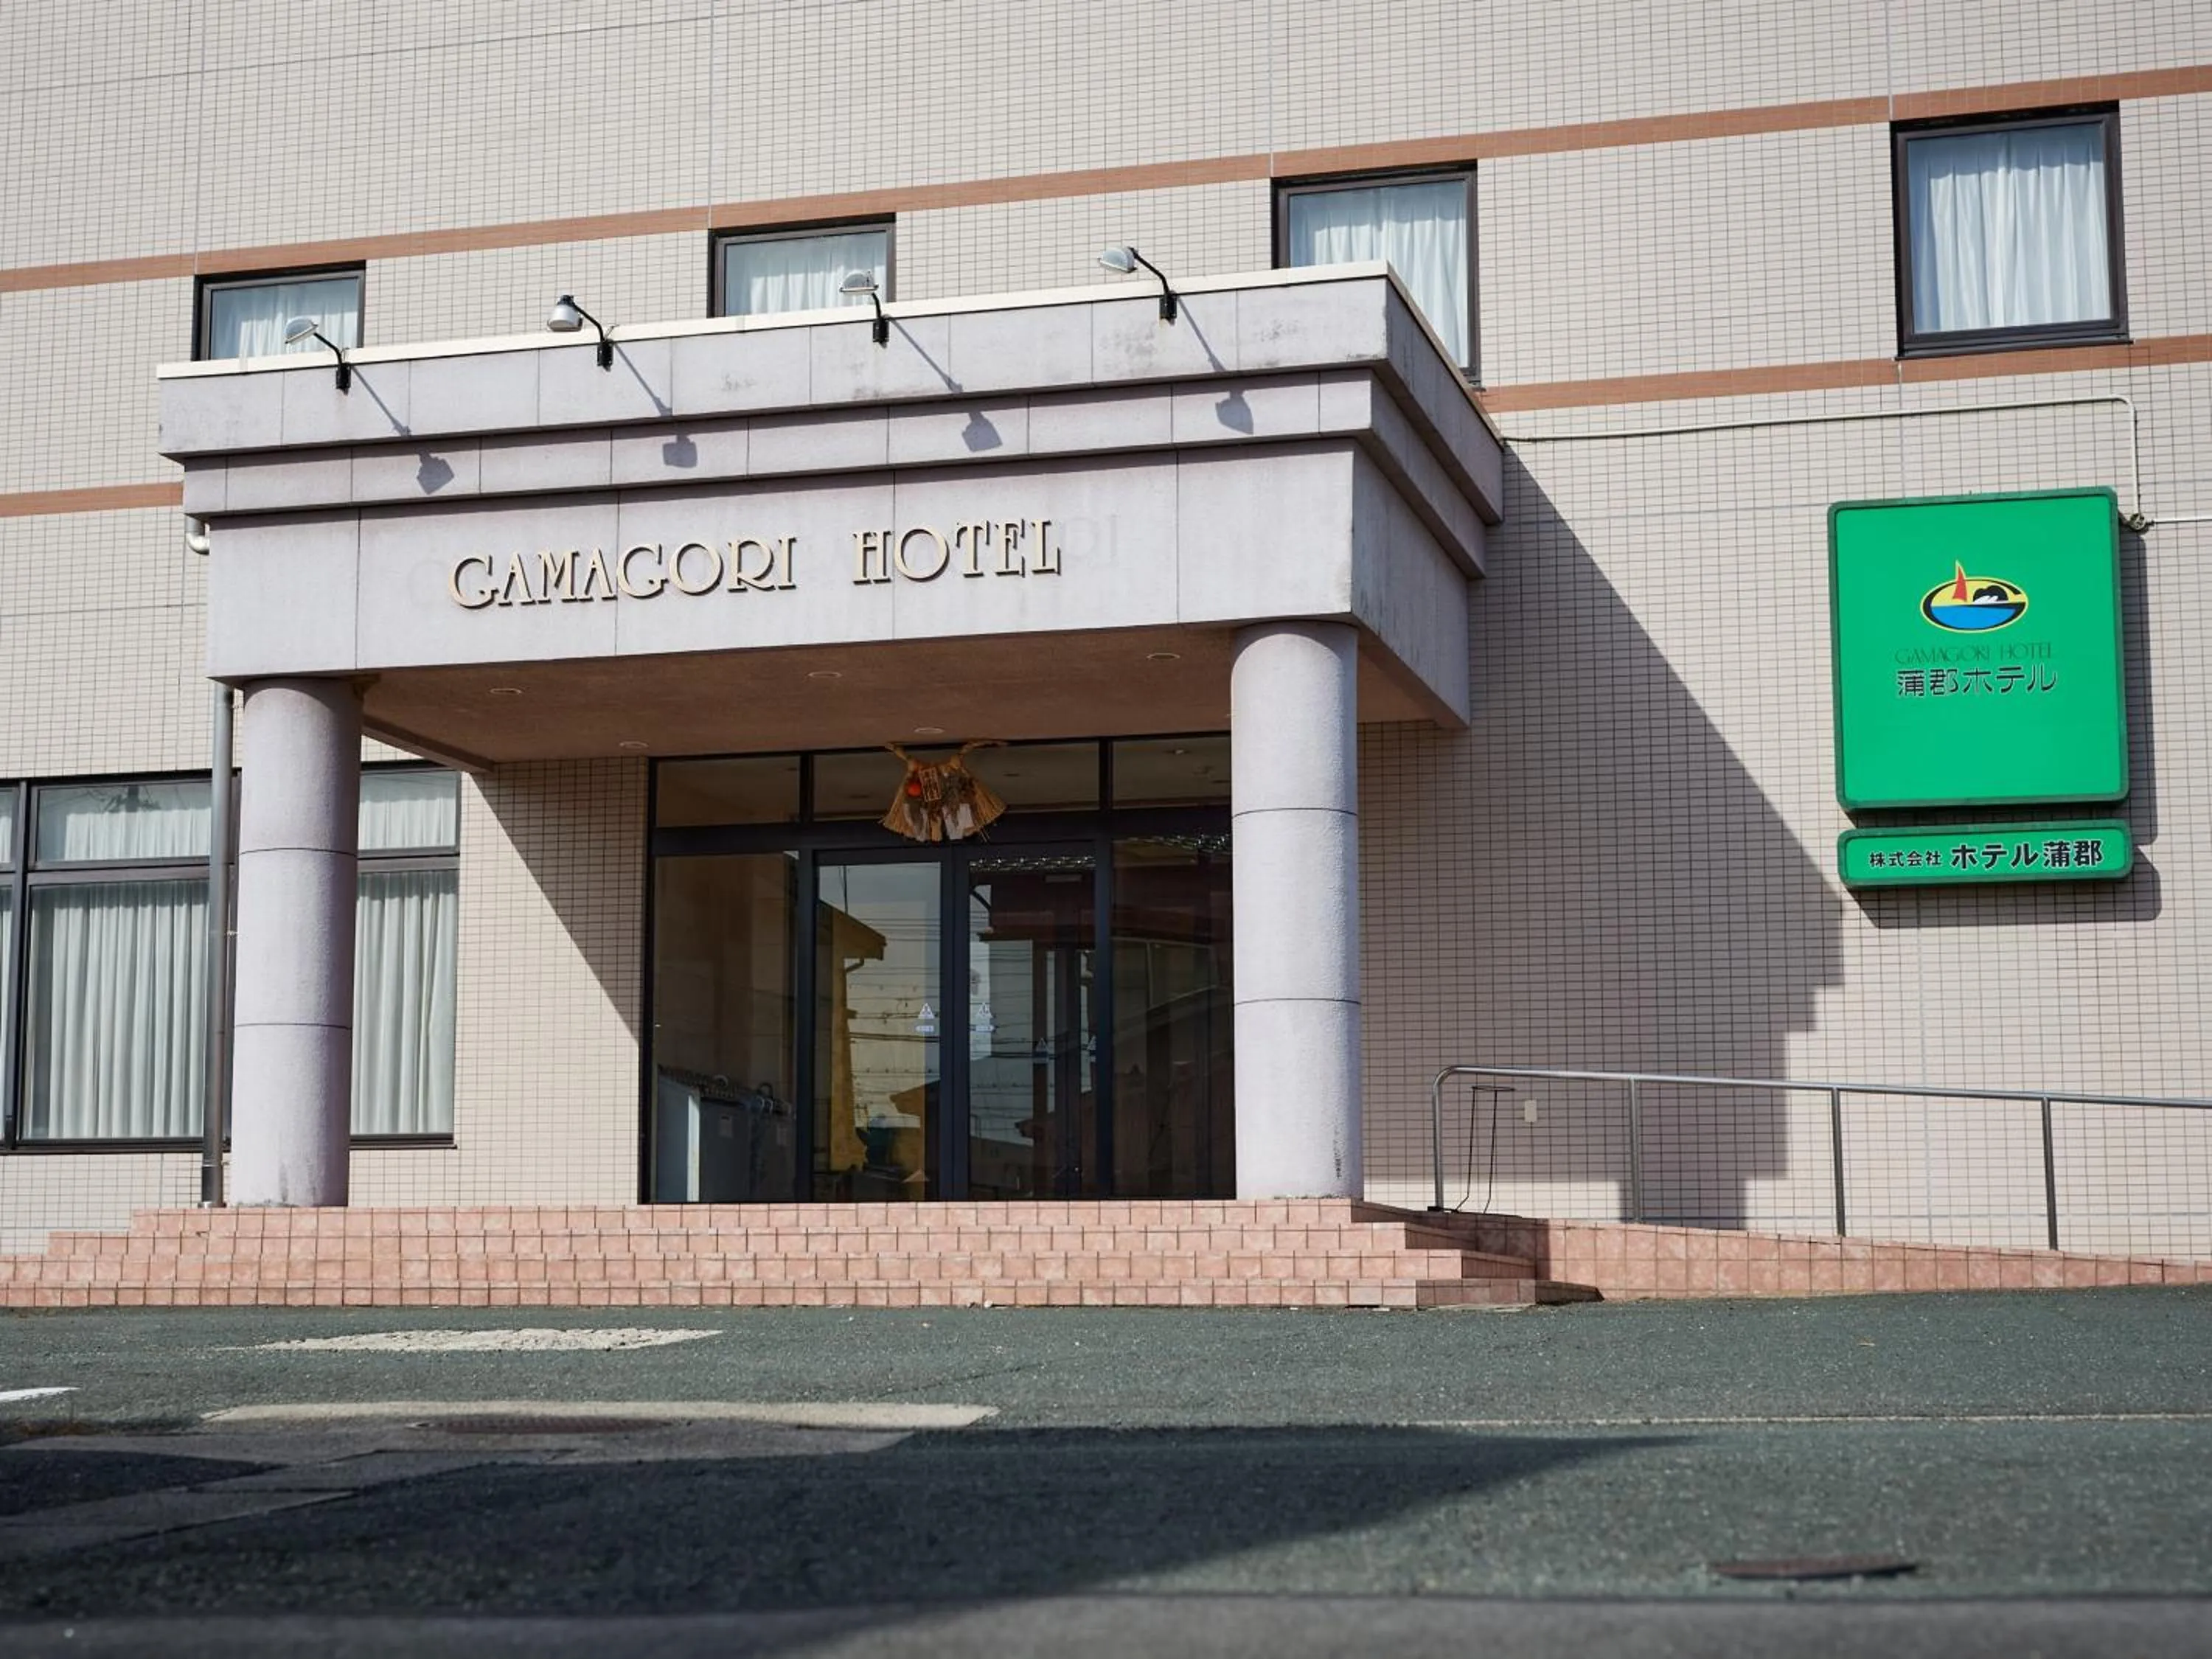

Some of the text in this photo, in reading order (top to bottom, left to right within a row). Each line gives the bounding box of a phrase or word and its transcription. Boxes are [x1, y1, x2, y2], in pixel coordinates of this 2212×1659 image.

[451, 519, 1060, 608] GAMAGORI HOTEL
[1896, 663, 2057, 697] 蒲郡ホテル
[1869, 839, 2103, 869] 株式会社 ホテル蒲郡
